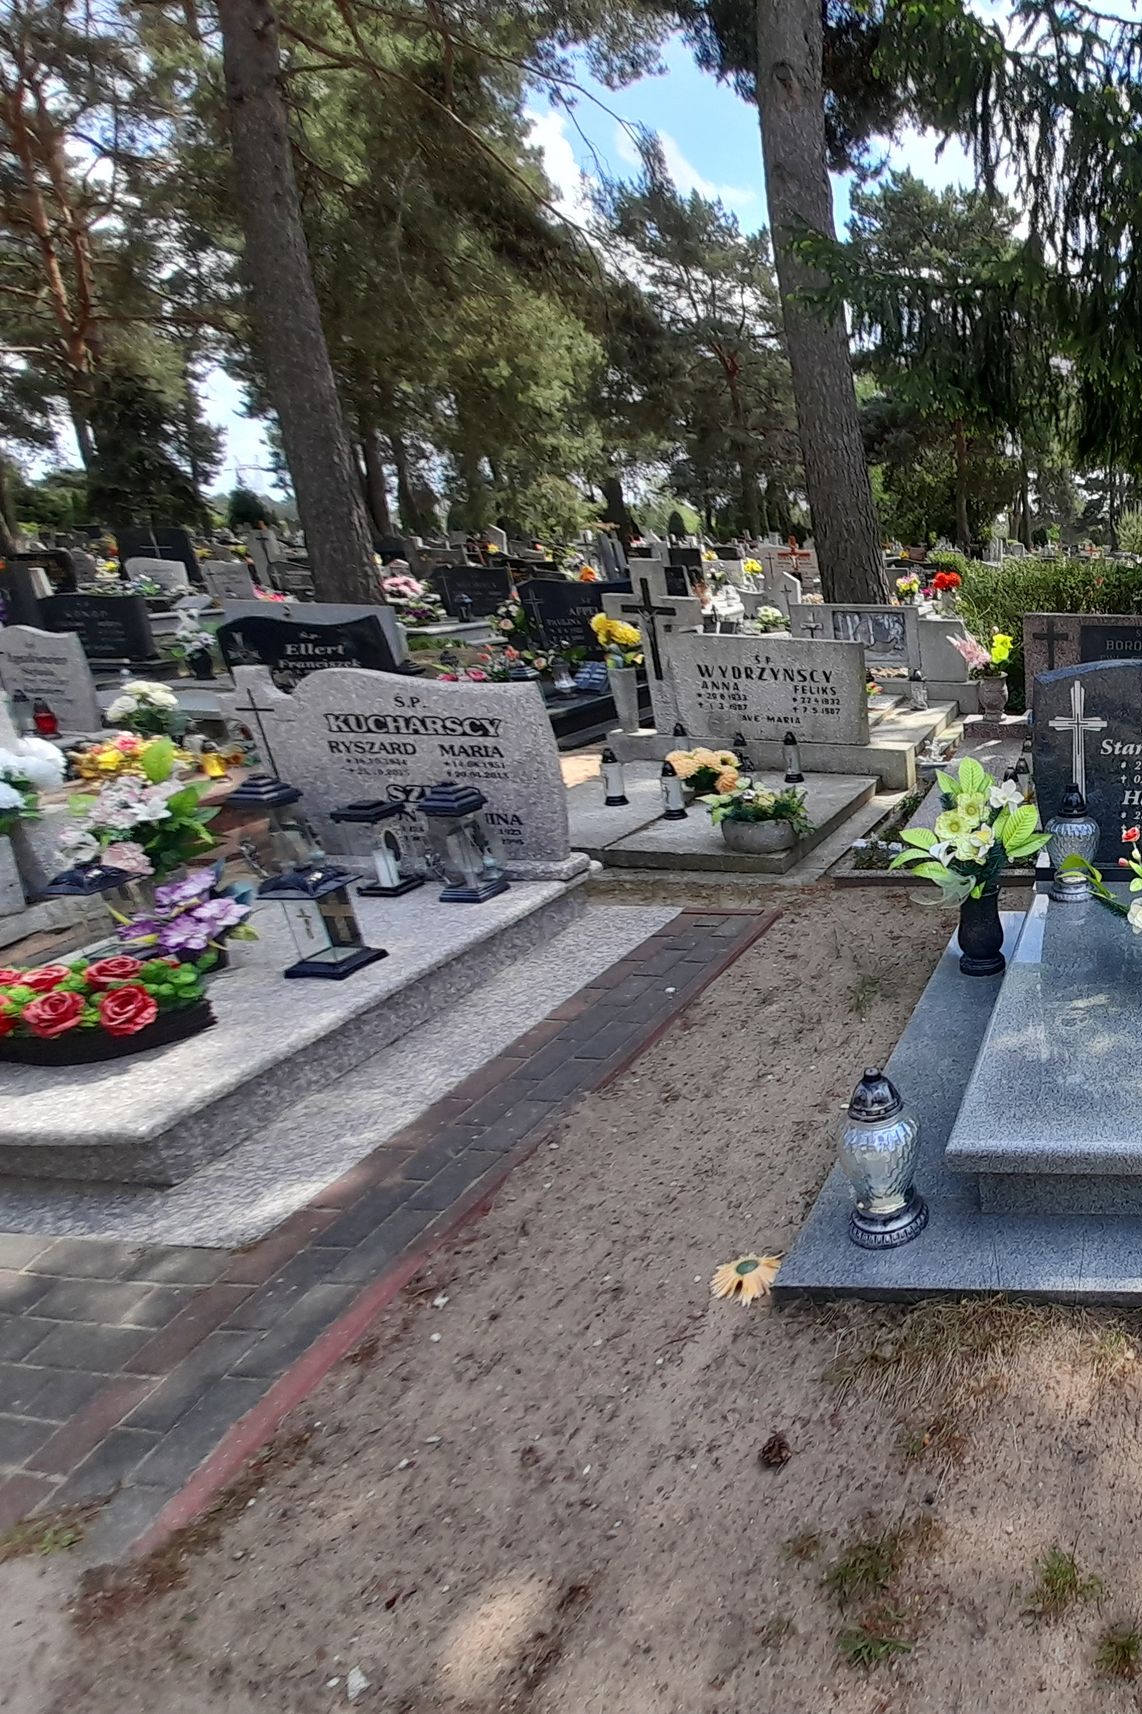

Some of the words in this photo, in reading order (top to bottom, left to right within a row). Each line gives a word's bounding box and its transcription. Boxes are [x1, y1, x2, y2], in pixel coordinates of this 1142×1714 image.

[285, 643, 345, 656] Ellert
[701, 681, 740, 691] ANNA
[794, 685, 837, 696] FELIKS
[324, 713, 501, 737] KUCHARSCY
[742, 714, 762, 722] AVE
[766, 716, 801, 724] MARIA
[328, 740, 417, 756] RYSZARD
[438, 744, 504, 758] MARIA
